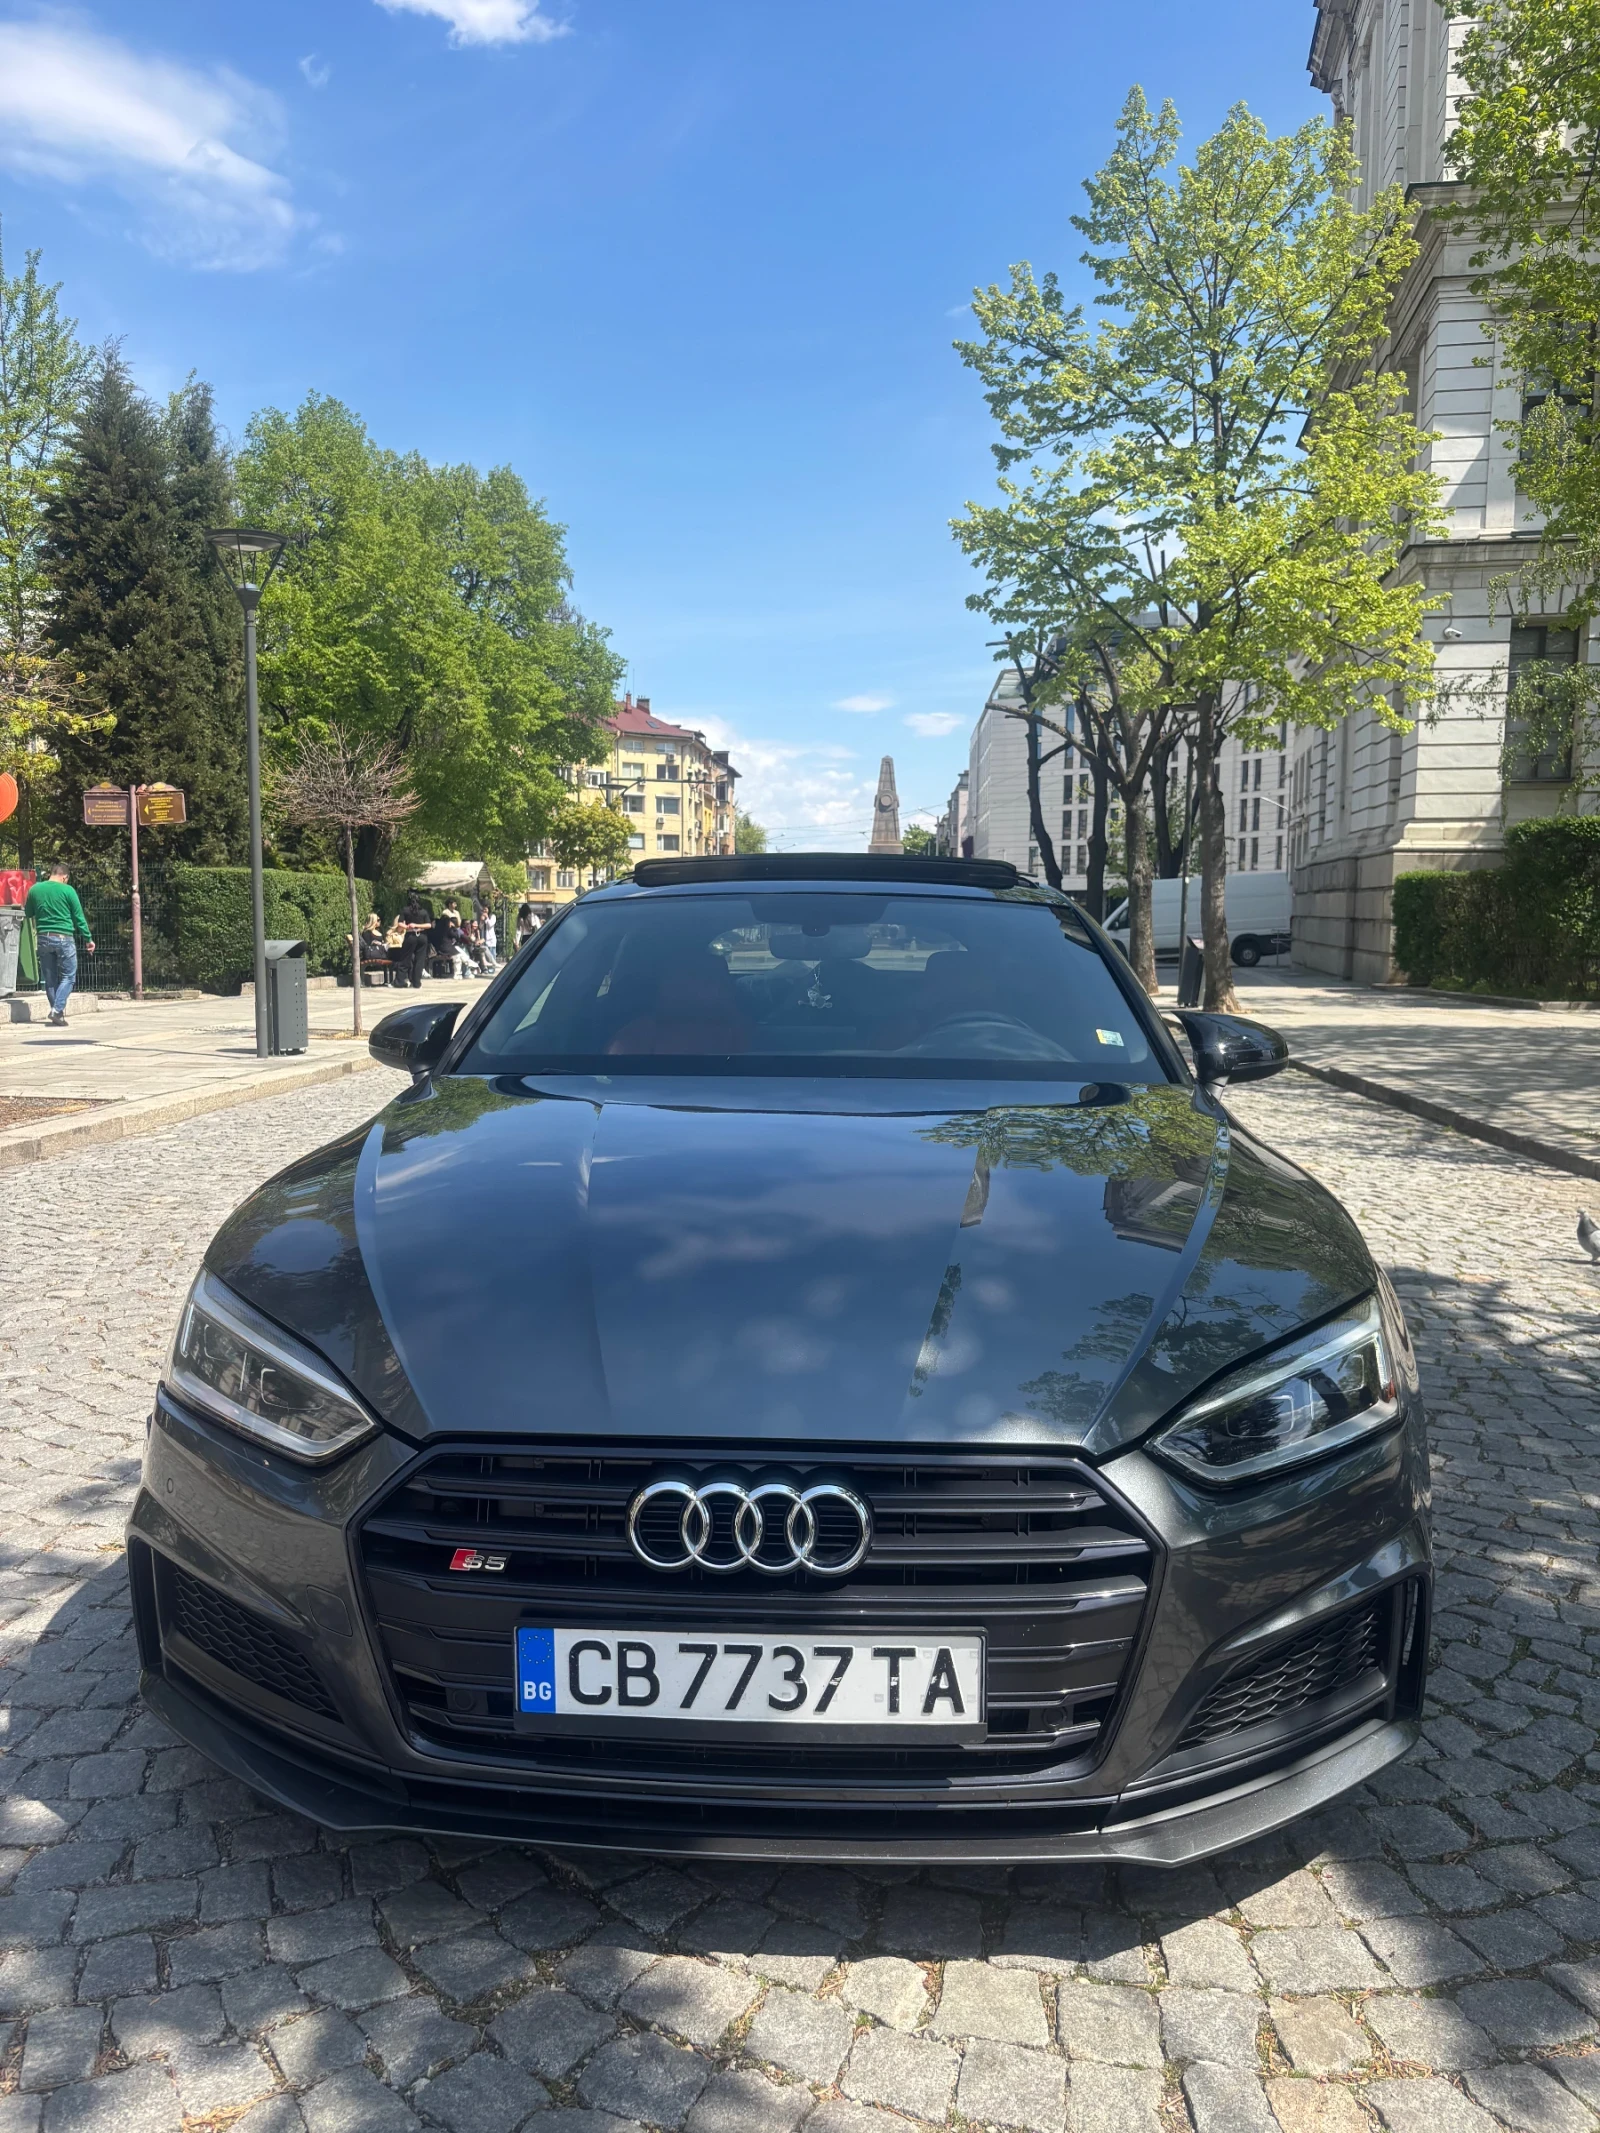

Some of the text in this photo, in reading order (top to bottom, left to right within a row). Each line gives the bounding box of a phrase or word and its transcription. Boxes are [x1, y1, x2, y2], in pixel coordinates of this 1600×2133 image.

[462, 1554, 507, 1571] S5
[568, 1640, 967, 1714] CB 7737 TA
[523, 1680, 552, 1701] BG
